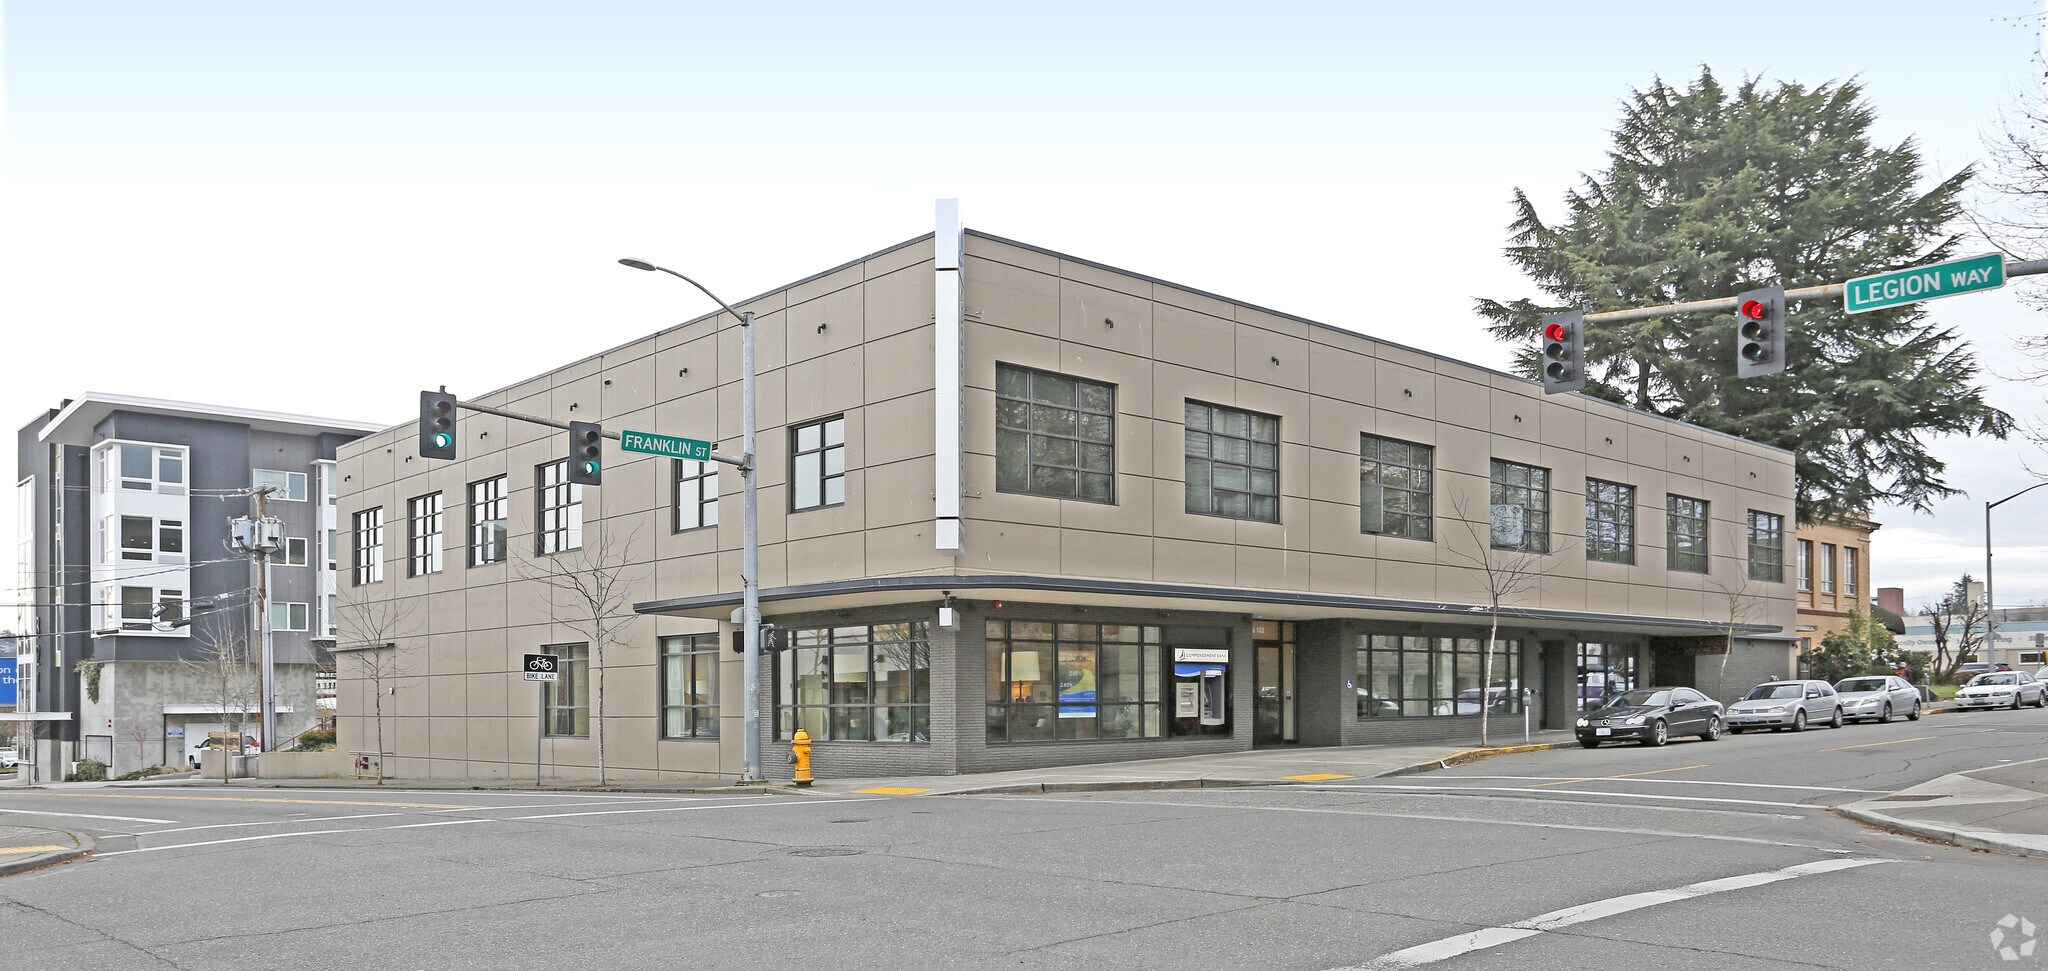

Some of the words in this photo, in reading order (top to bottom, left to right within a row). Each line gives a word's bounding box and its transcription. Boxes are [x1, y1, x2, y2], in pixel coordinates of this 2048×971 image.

[1855, 271, 1940, 305] LEGION
[1951, 266, 1993, 288] WAY
[625, 434, 691, 456] FRANKLIN
[695, 446, 707, 458] ST
[2, 675, 18, 684] th
[526, 672, 538, 680] BIKE
